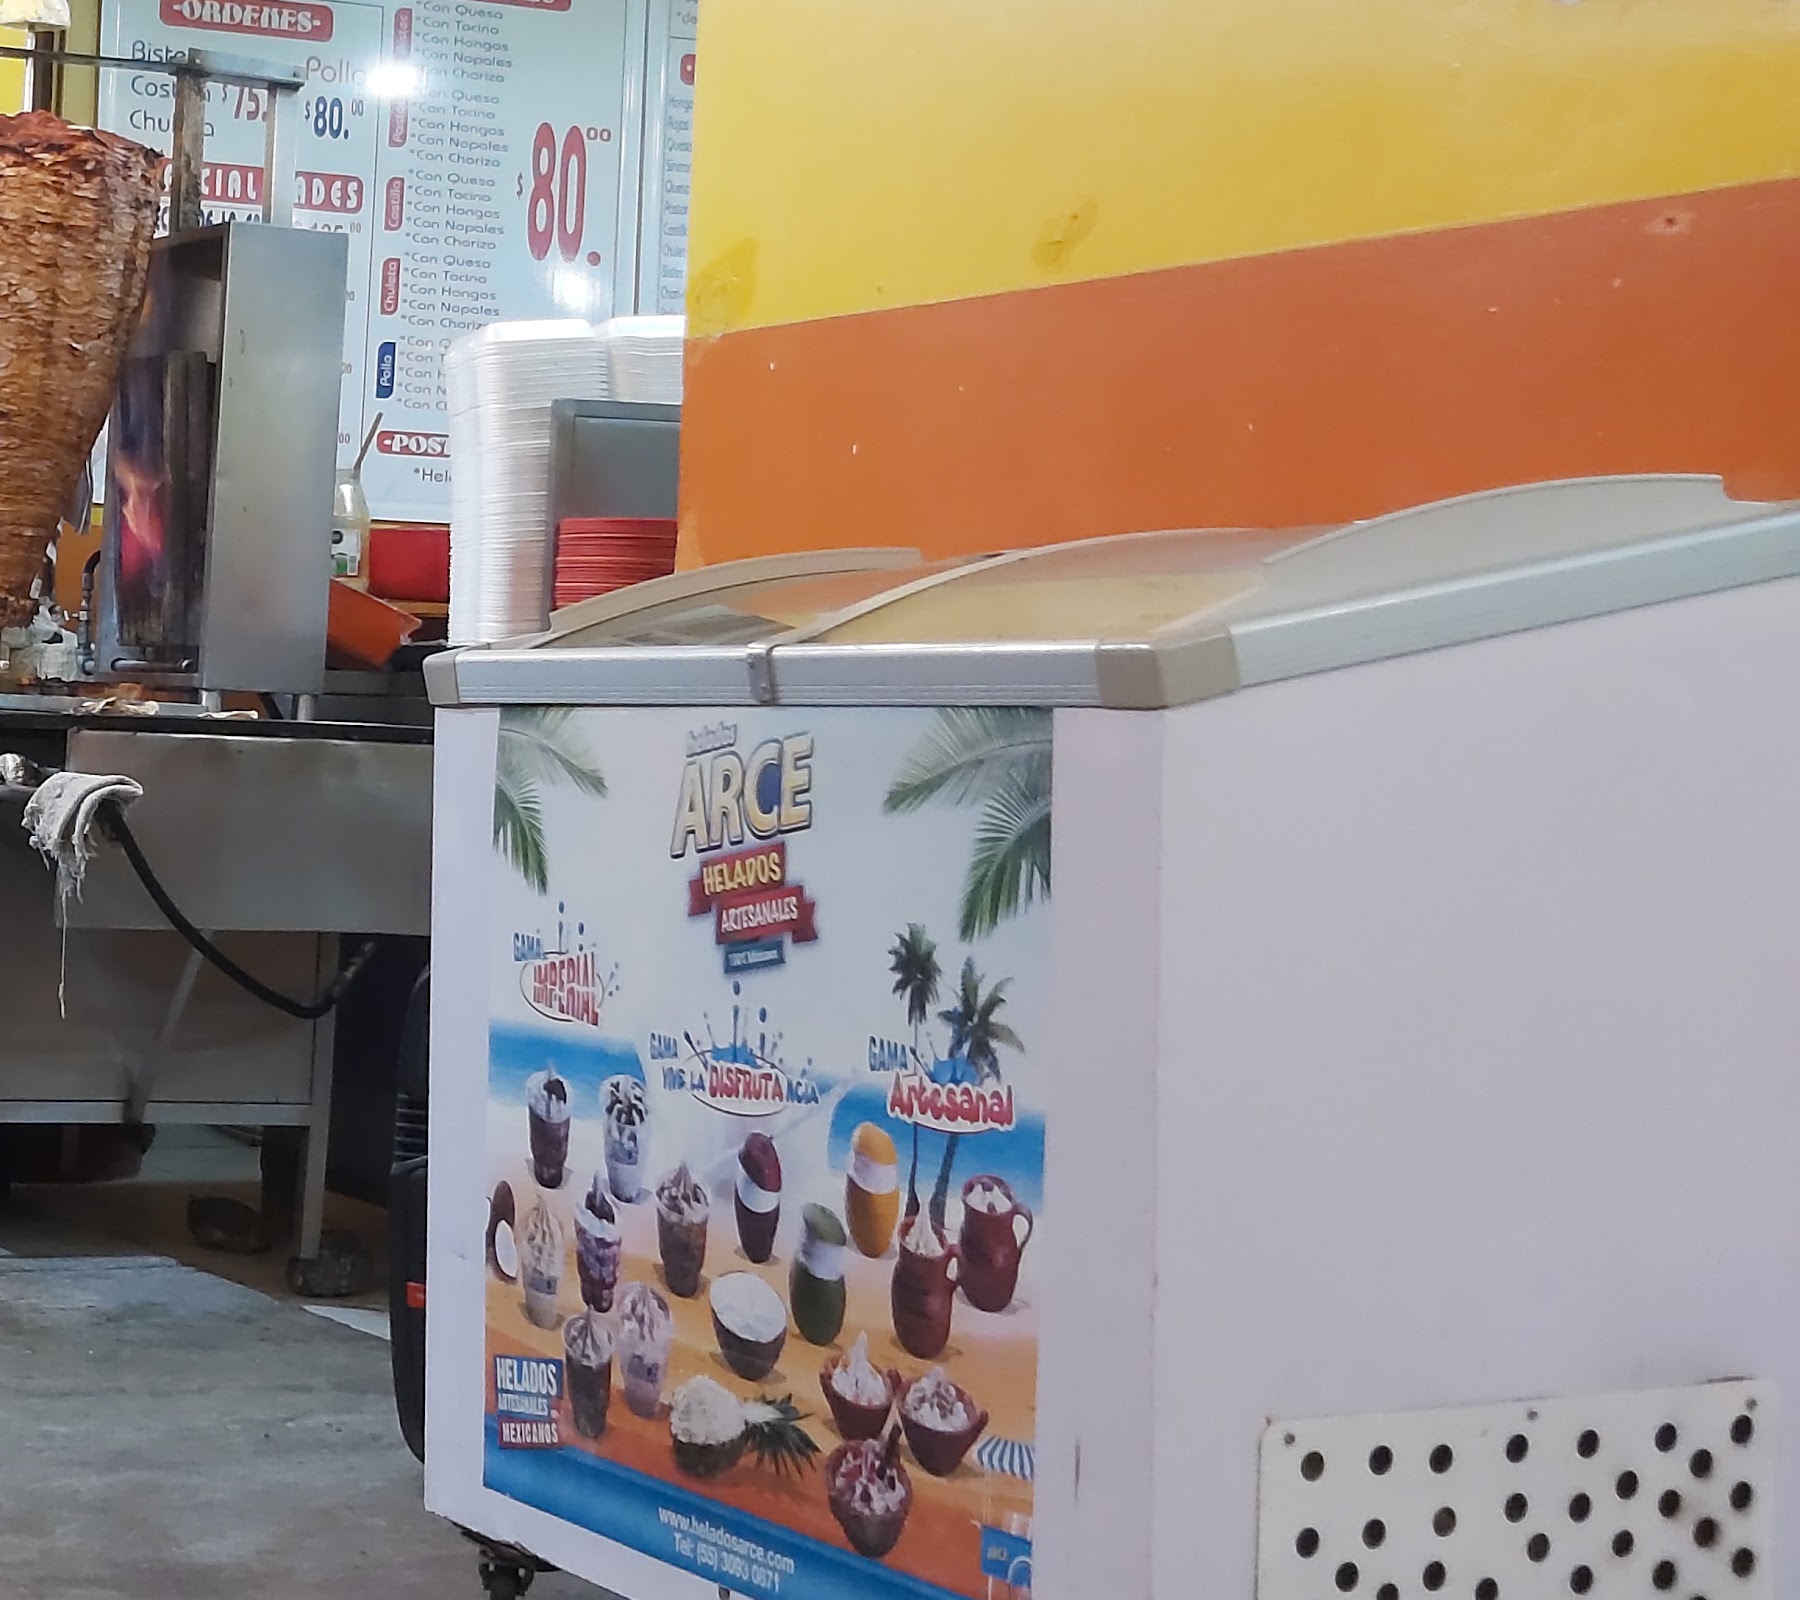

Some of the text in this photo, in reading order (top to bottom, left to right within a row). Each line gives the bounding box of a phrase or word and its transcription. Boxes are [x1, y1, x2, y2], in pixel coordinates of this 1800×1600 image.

[455, 4, 503, 20] Queso
[455, 20, 499, 35] Tocino
[454, 36, 509, 52] Hongos
[453, 52, 512, 68] Nopales
[453, 68, 505, 83] Chorizo
[452, 89, 499, 104] Queso
[452, 105, 495, 119] Tocino
[450, 121, 505, 137] Hongos
[450, 137, 509, 152] Nopales
[448, 153, 501, 168] Chorizo
[447, 173, 496, 187] Queso
[448, 188, 491, 203] Tocino
[388, 180, 401, 228] Costilla
[446, 204, 501, 220] Hongos
[445, 220, 505, 235] Nopales
[444, 236, 497, 250] Chorizo
[443, 255, 491, 269] Queso
[443, 271, 487, 284] Tocino
[383, 262, 398, 312] Chuleta
[441, 286, 496, 302] Hongos
[440, 302, 500, 317] Nopales
[380, 354, 392, 387] Pollo
[670, 731, 814, 860] ARCE
[702, 852, 782, 897] HELADOS
[721, 896, 799, 933] ARTESANALES
[513, 932, 548, 962] GAMA
[650, 1032, 678, 1060] GAMA
[869, 1036, 908, 1071] GAMA
[690, 1070, 706, 1092] LA
[890, 1072, 1014, 1127] Artesanal
[496, 1357, 557, 1396] HELADOS
[502, 1422, 558, 1444] MEXICANOS
[658, 1506, 795, 1575] www.heladosarce.com
[697, 1541, 718, 1571] (55)
[751, 1565, 779, 1593] 0871
